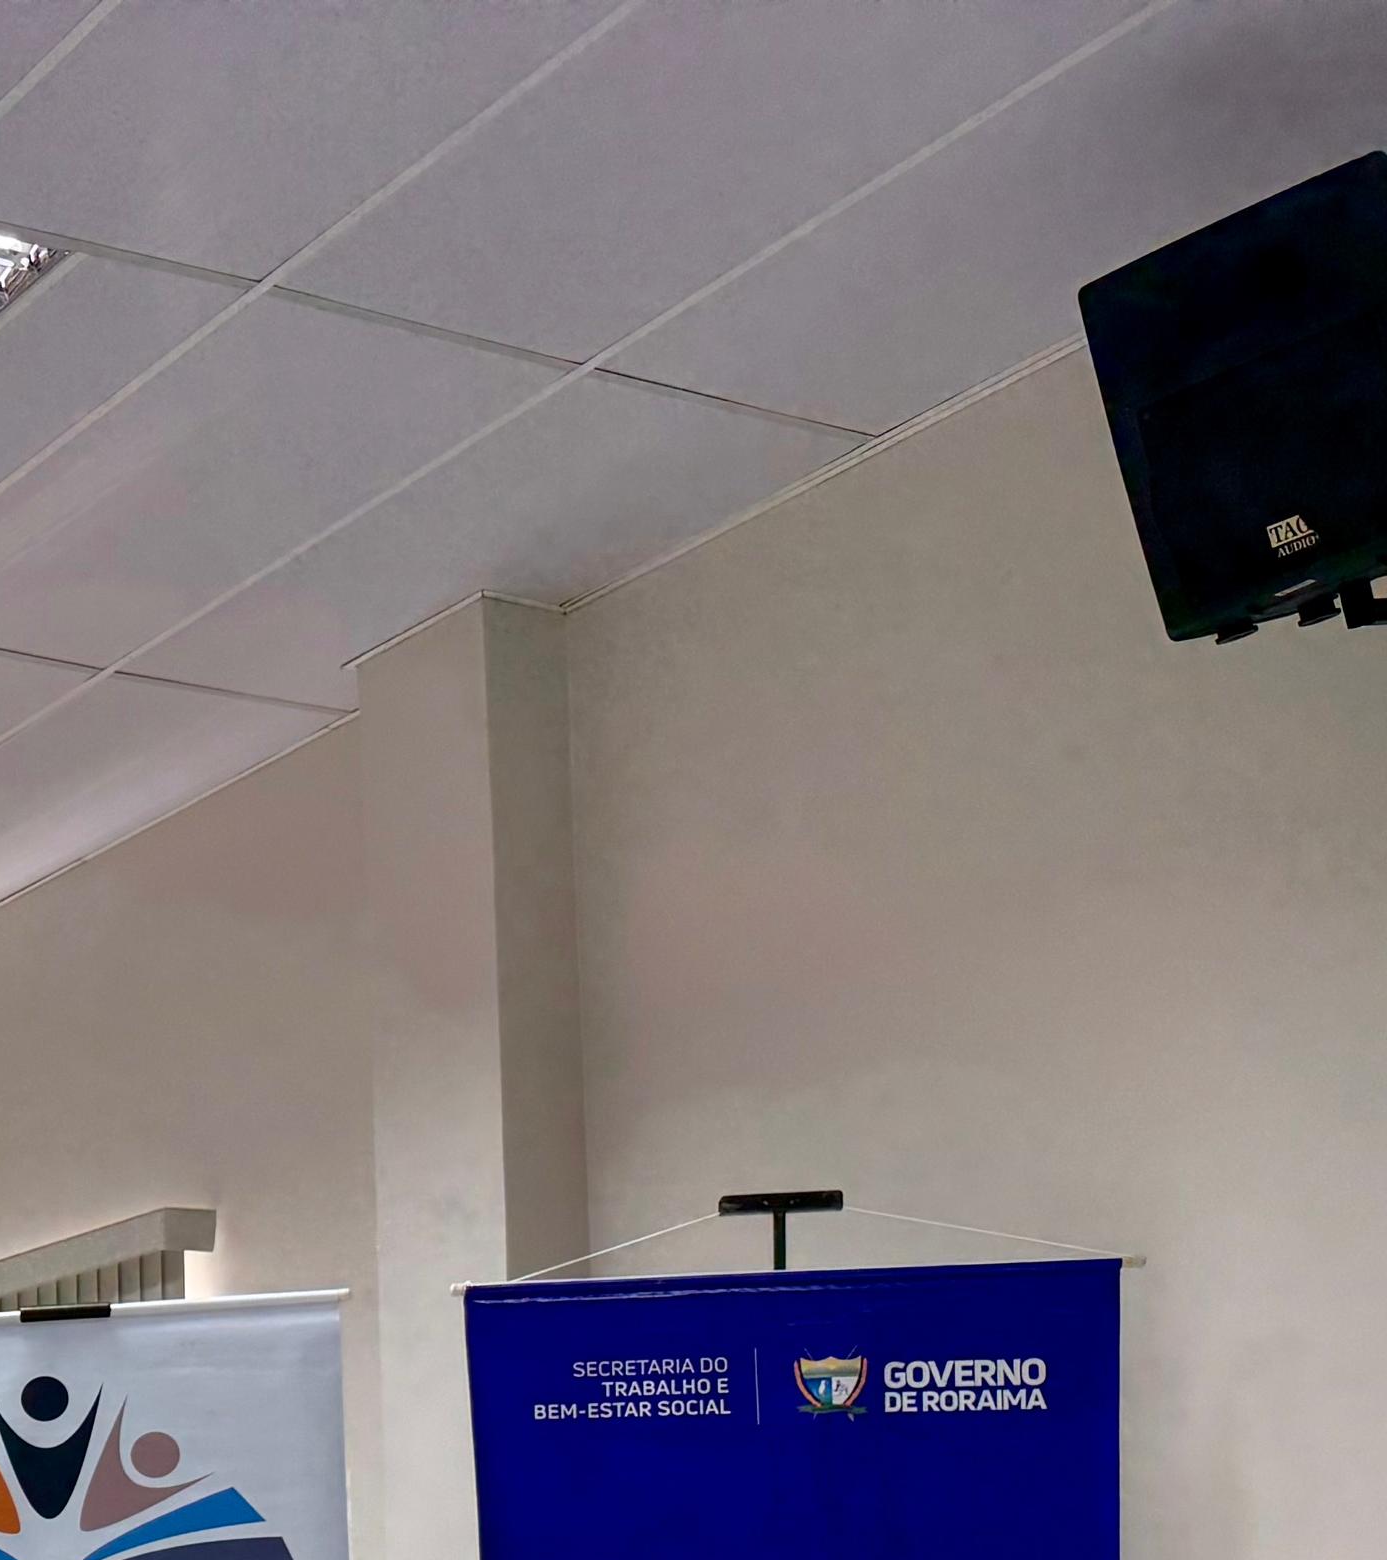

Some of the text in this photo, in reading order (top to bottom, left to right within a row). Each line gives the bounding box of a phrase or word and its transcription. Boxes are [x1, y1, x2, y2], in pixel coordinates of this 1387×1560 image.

[572, 1356, 728, 1378] SECRETARIA DO
[883, 1357, 1047, 1389] GOVERNO
[601, 1377, 730, 1398] TRABALHO E
[533, 1398, 732, 1420] BEM-ESTAR SOCIAL
[884, 1388, 1048, 1413] DE RORAIMA
